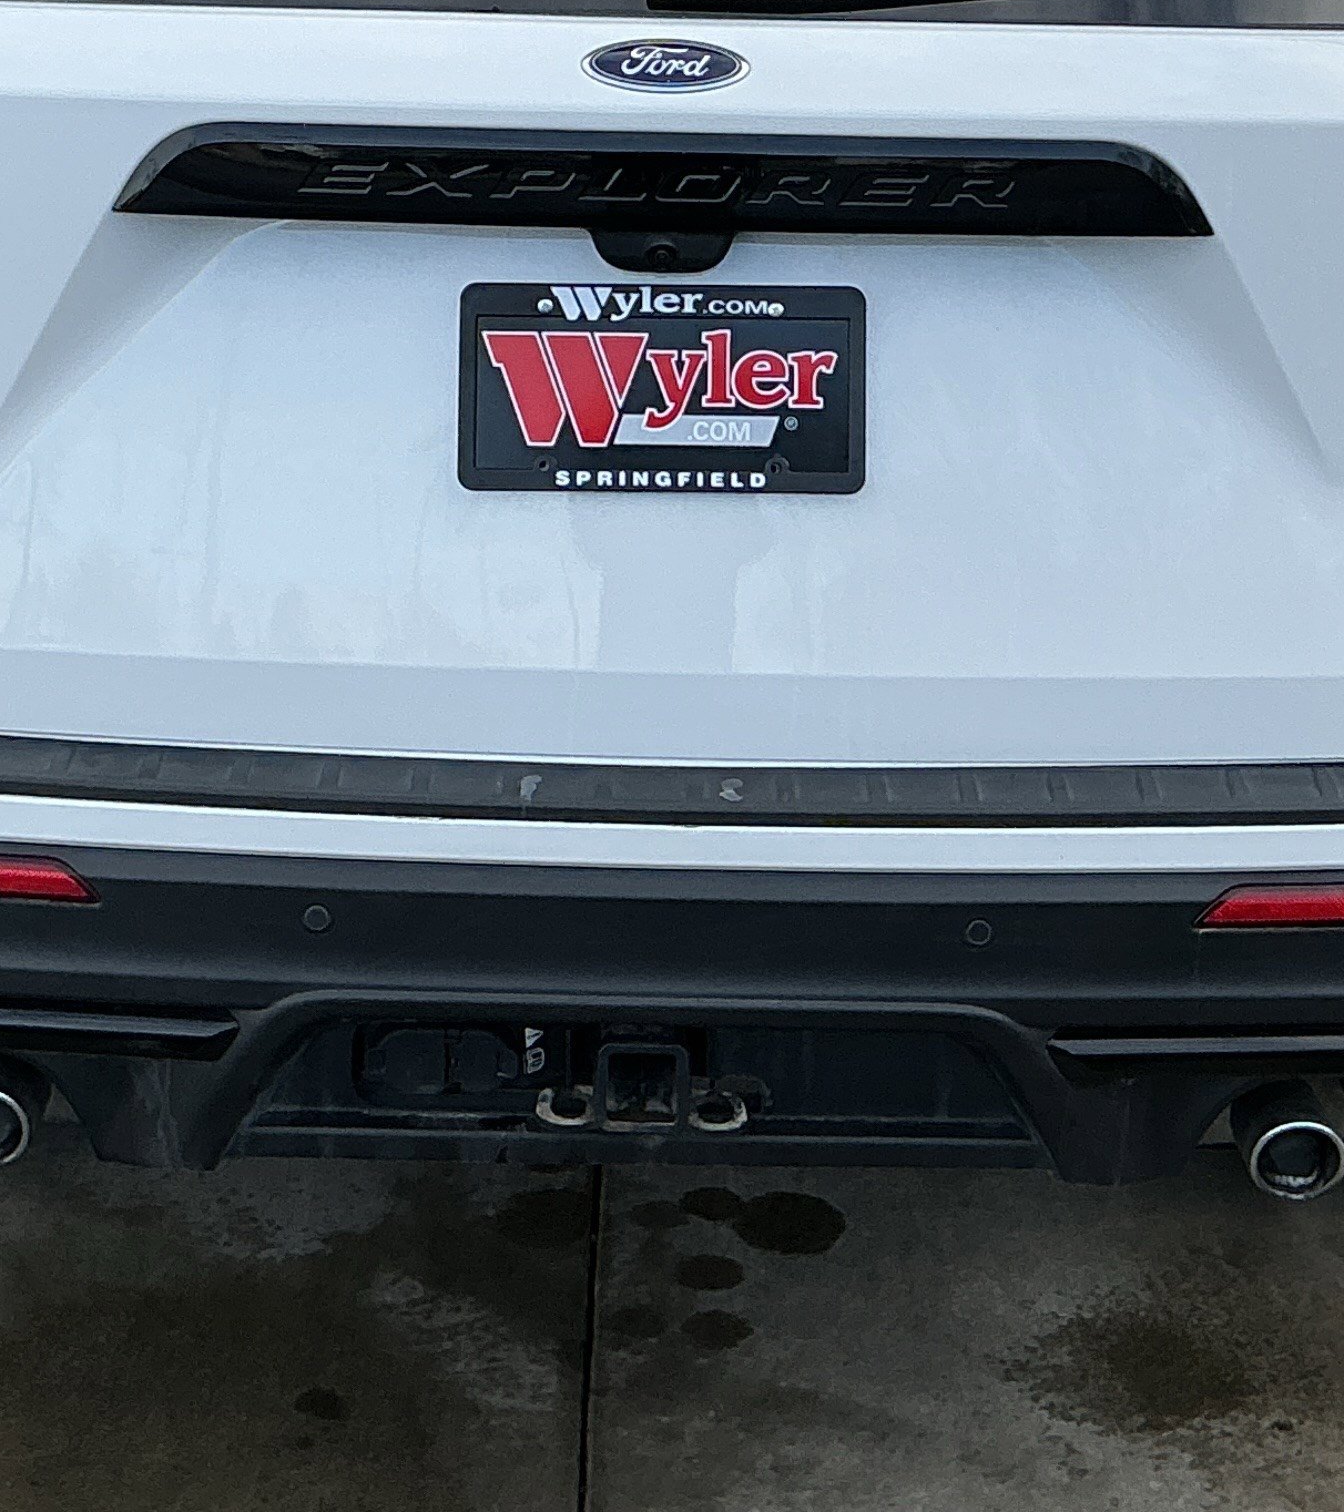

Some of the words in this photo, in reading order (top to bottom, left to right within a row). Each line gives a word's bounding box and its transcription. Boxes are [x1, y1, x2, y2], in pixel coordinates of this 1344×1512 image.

[621, 46, 711, 76] Ford
[296, 158, 1017, 208] EXPLORER
[481, 329, 839, 448] Wyler
[554, 470, 767, 489] SPRINGFIELD
